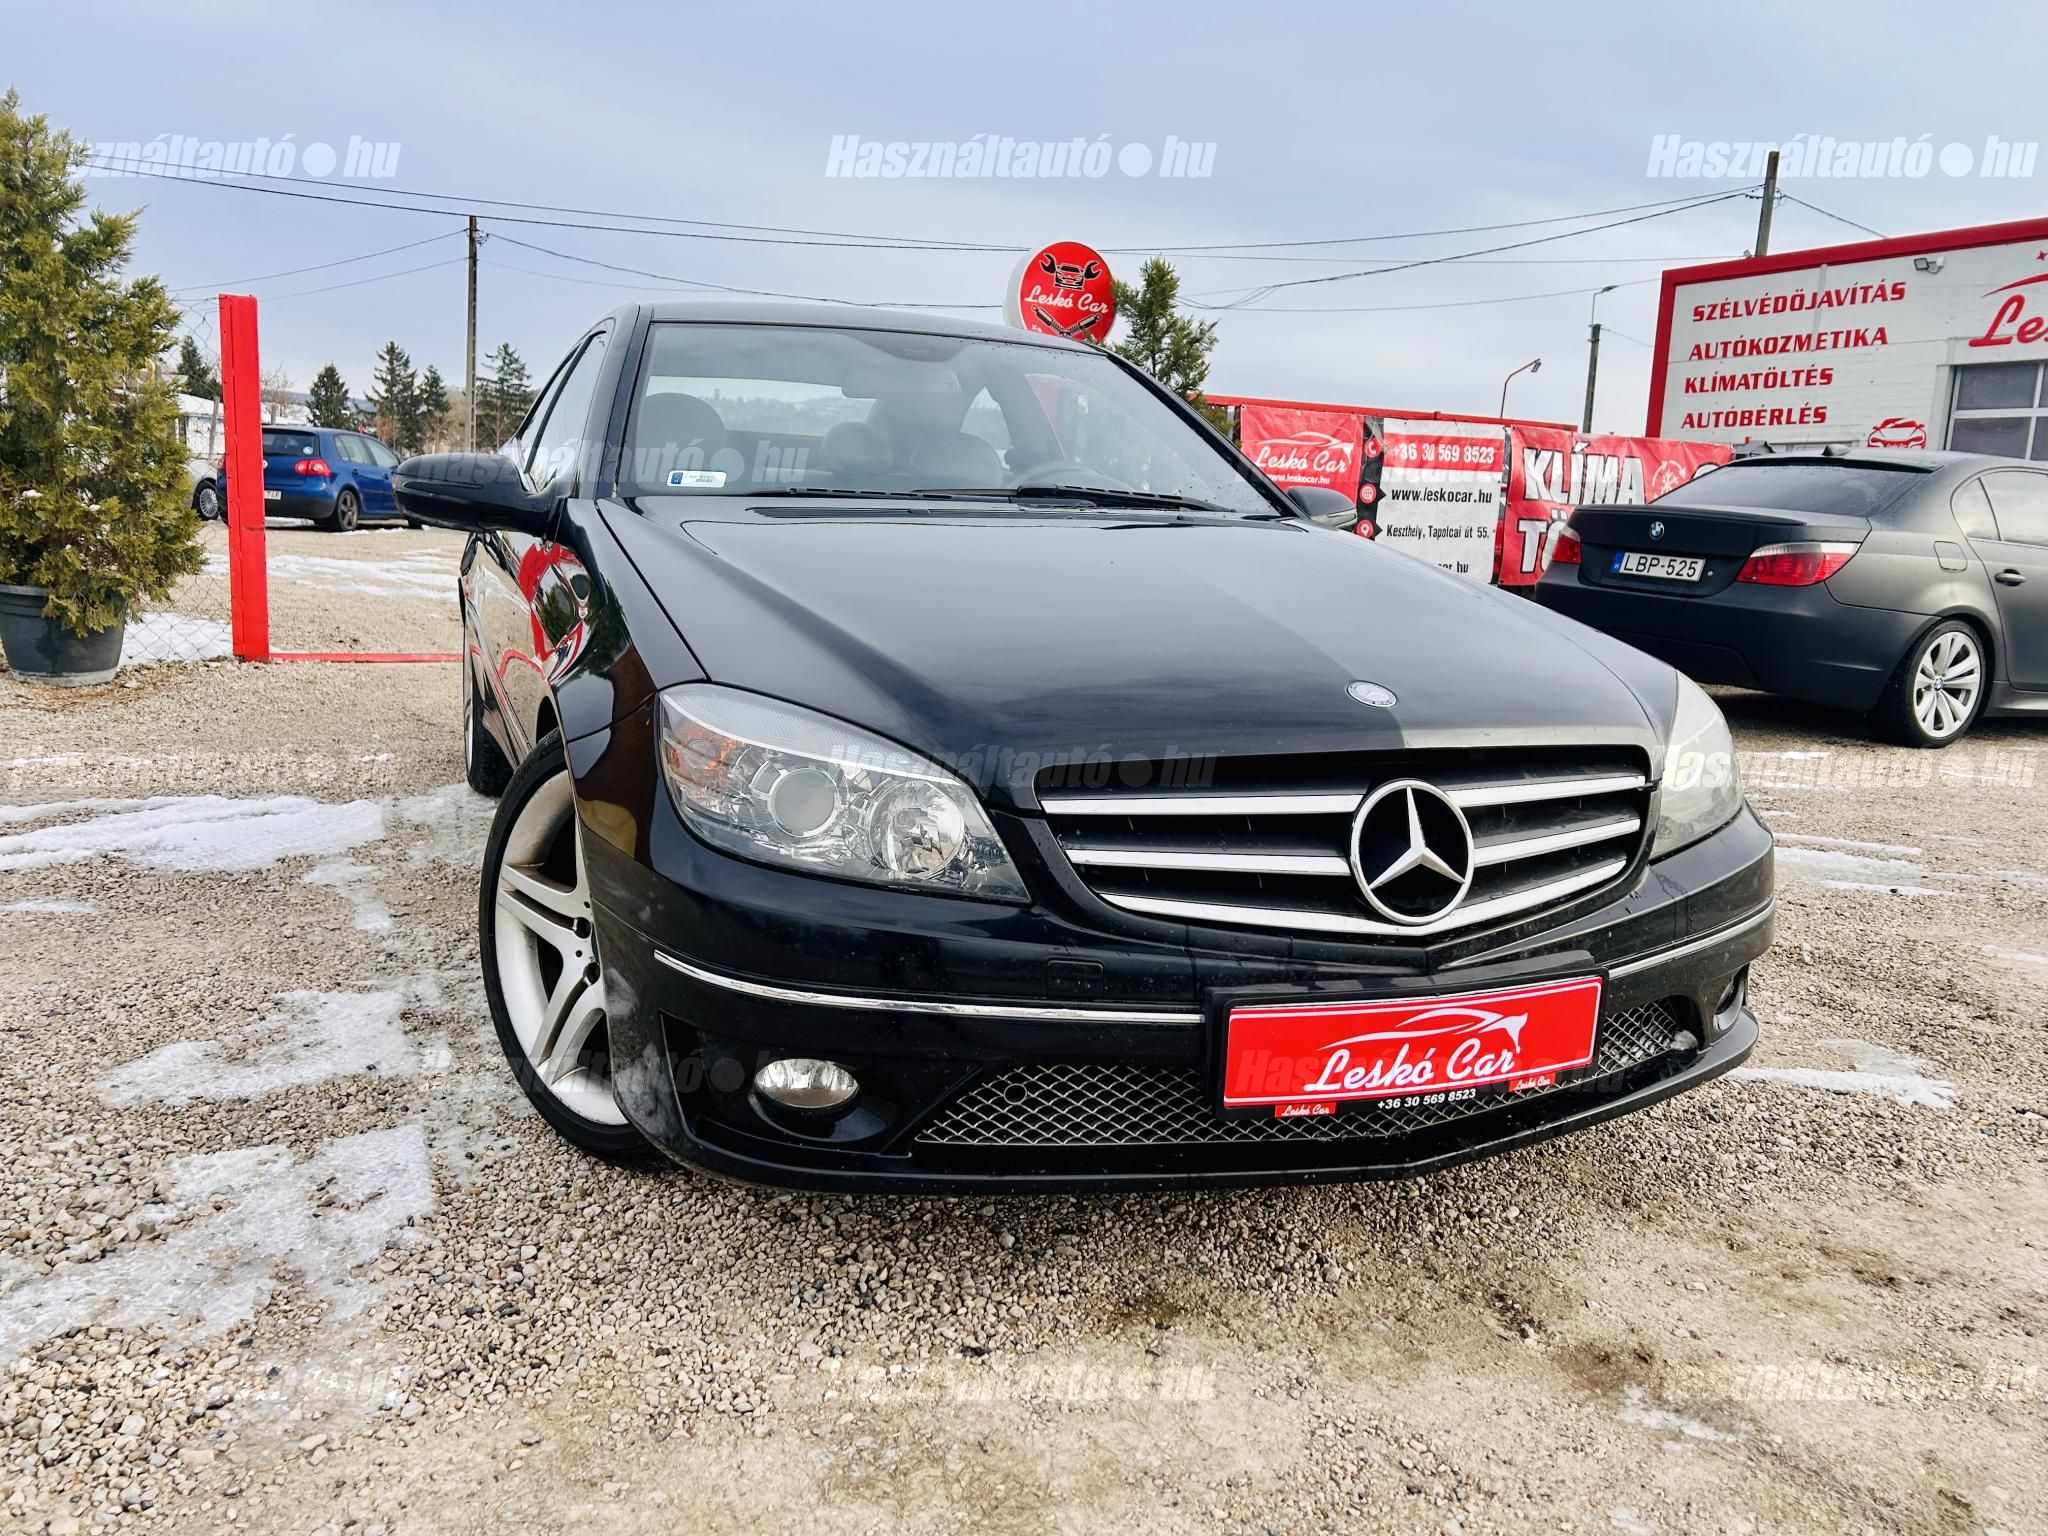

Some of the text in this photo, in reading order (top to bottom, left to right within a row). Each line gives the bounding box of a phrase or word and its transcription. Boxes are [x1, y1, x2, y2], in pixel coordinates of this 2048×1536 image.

[1024, 285, 1109, 314] Leskó Car
[1968, 294, 2048, 347] Le
[1688, 326, 1889, 361] AUTÓKOZMETIKA
[1684, 364, 1834, 394] KLÍMATÖLTÉS
[1681, 402, 1828, 429] AUTÓBÉRLÉS
[1254, 446, 1348, 473] Leskó Car
[1393, 442, 1496, 464] +36 30 569 8523
[1523, 441, 1647, 504] KLÍMA
[1391, 487, 1492, 503] www.leskocar.hu
[1386, 524, 1490, 541] Keszthely, Tapolcai út 55.
[1623, 554, 1698, 577] LBP-525
[1303, 1043, 1436, 1092] Leskó
[1445, 1037, 1515, 1080] Car
[1312, 1104, 1330, 1115] Car
[1377, 1088, 1477, 1109] +36 30 569 8523
